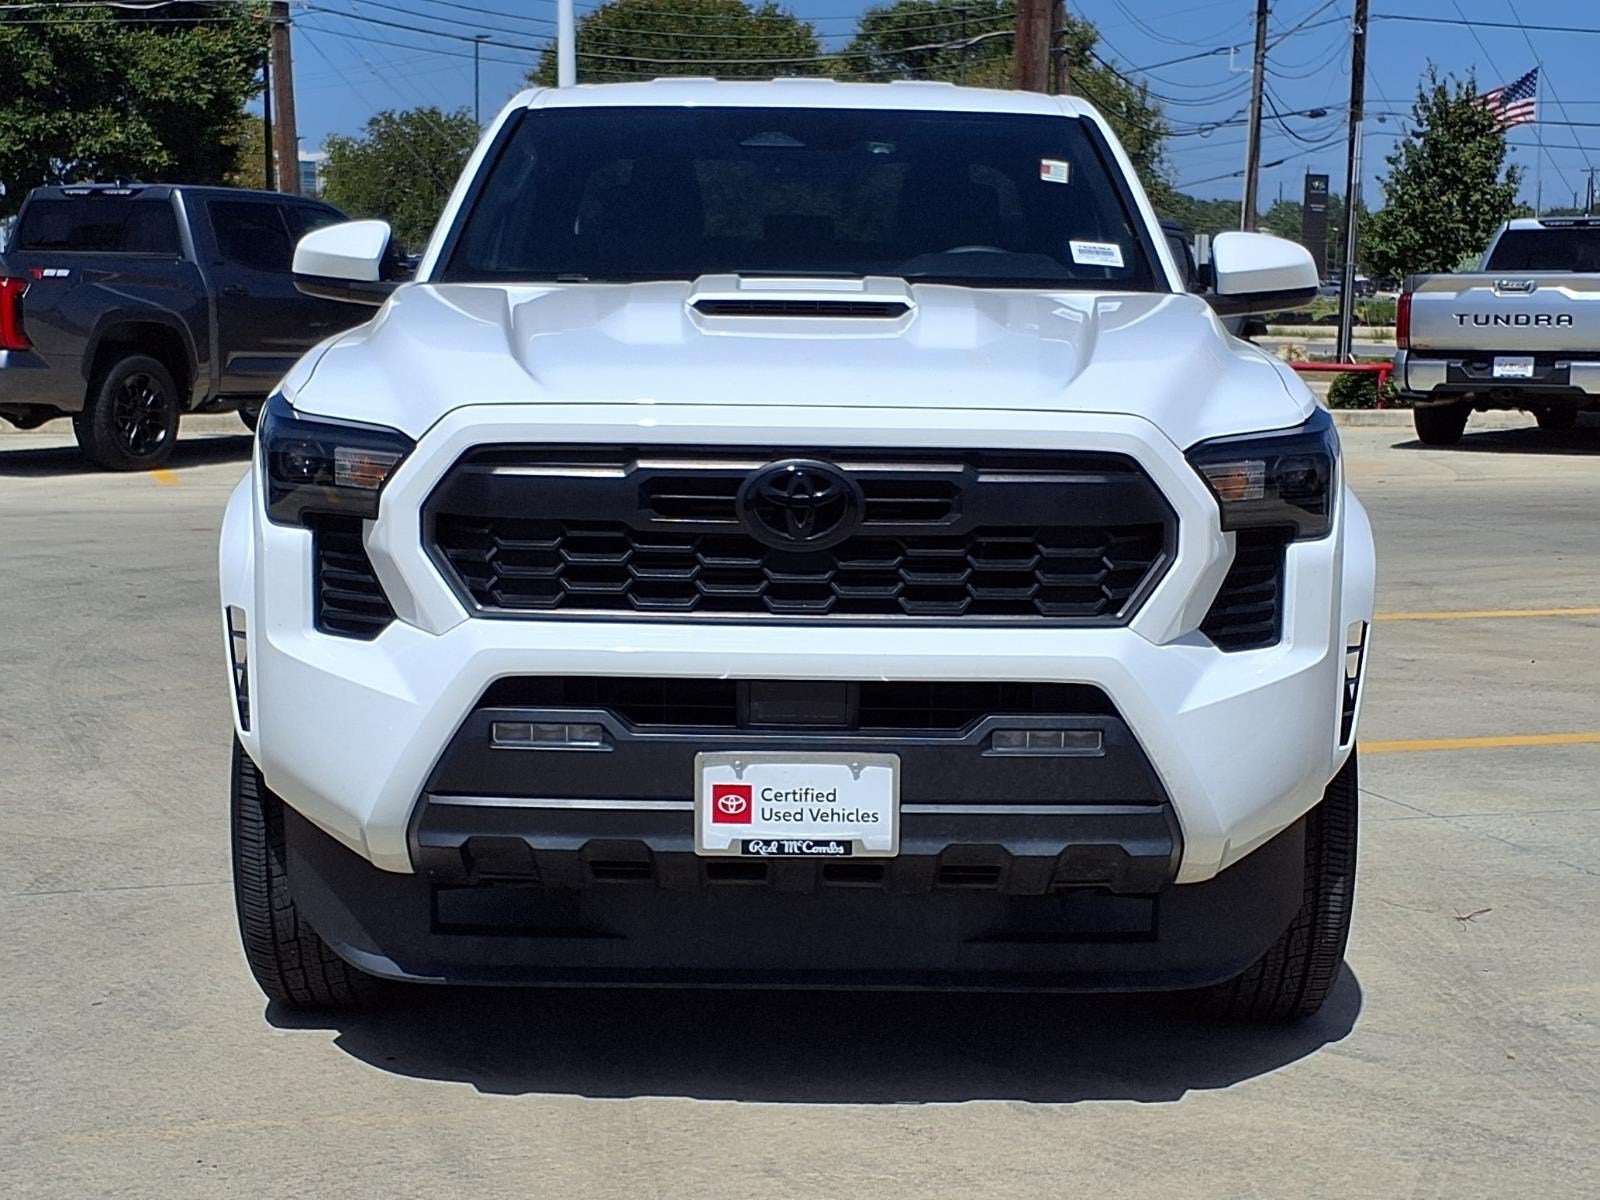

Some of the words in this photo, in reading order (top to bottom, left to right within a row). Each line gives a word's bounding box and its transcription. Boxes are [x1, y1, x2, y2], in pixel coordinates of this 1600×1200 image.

[1453, 313, 1573, 328] TUNDRA
[760, 787, 837, 803] Certified
[760, 807, 804, 822] Used
[809, 807, 879, 823] Vehicles
[748, 840, 778, 855] Red
